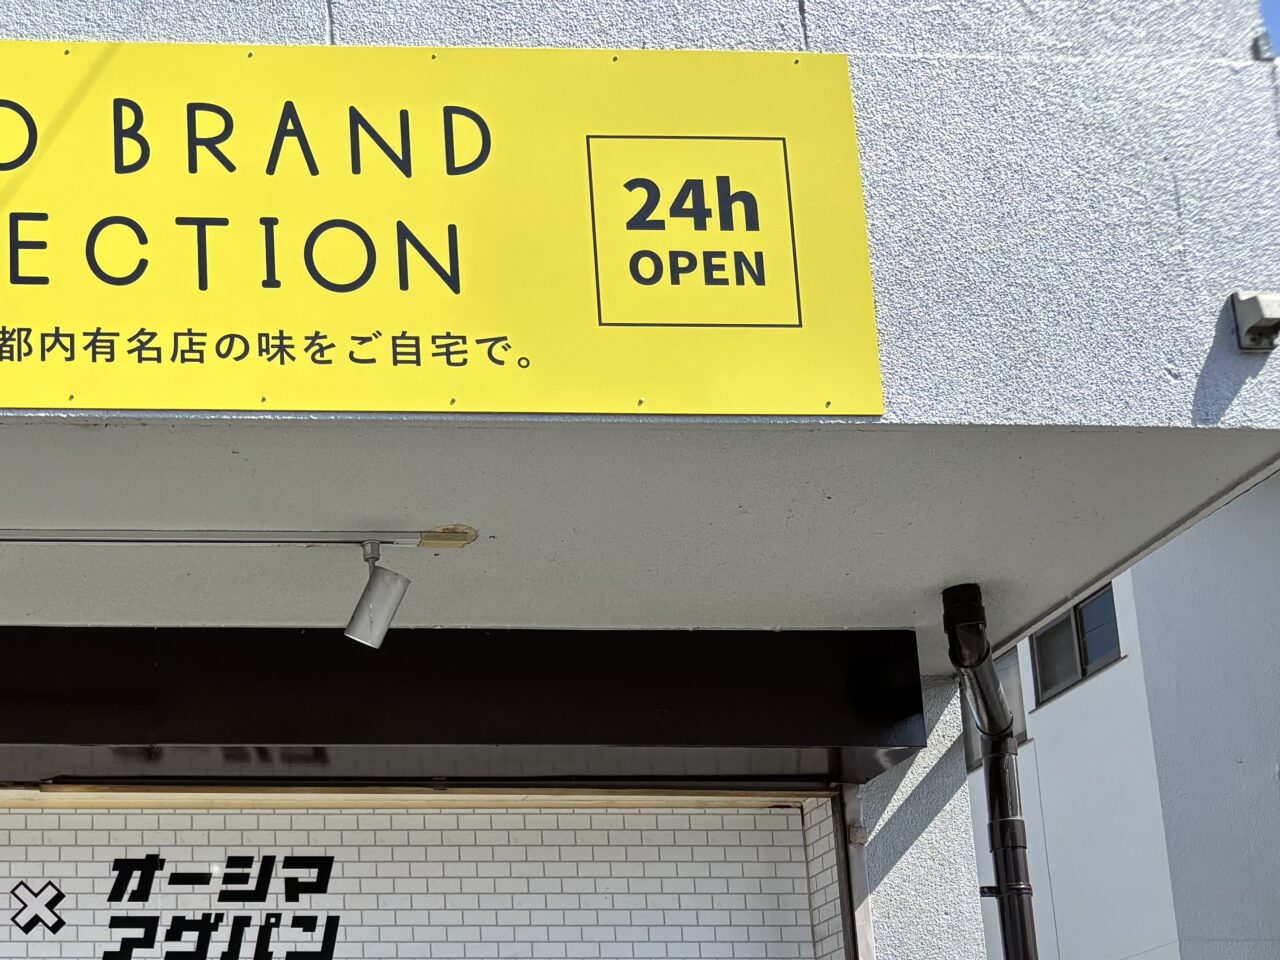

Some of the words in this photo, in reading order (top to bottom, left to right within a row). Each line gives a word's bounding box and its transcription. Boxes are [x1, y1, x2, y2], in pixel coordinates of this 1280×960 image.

[112, 97, 492, 179] BRAND
[623, 175, 760, 232] 24h
[629, 249, 766, 286] OPEN
[106, 853, 335, 903] オーシマ
